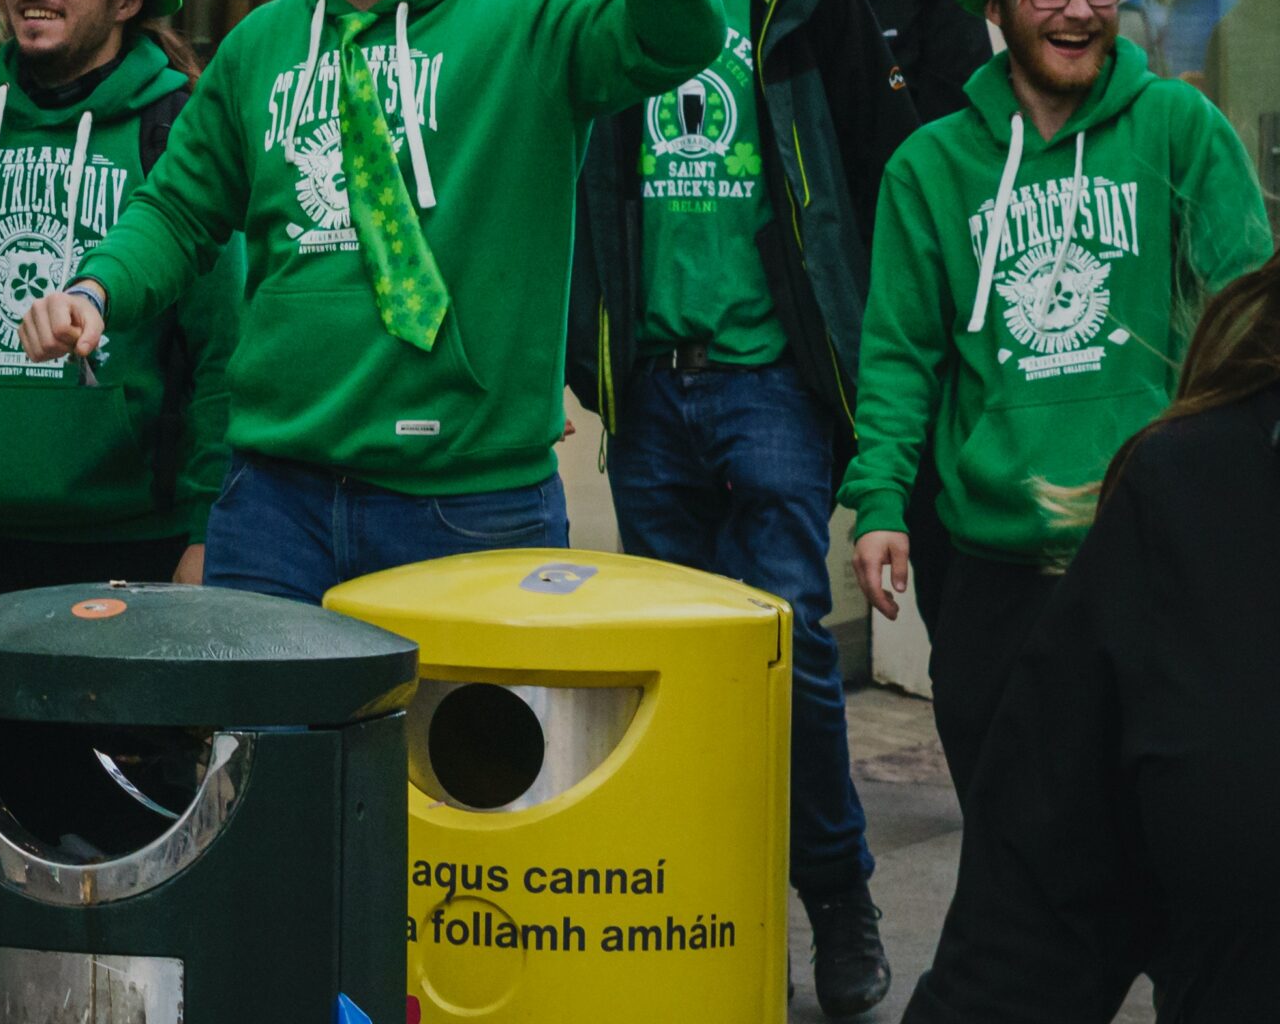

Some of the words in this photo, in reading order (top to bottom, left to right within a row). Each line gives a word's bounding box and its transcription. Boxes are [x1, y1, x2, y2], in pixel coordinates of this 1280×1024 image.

[643, 179, 716, 198] ATRICK'S
[718, 179, 755, 198] DAY
[668, 160, 717, 178] SAINT
[1009, 175, 1090, 206] RELAND
[80, 165, 128, 238] DAY
[1094, 181, 1140, 257] DAY
[412, 859, 510, 904] agus
[523, 858, 667, 895] cannaí
[431, 909, 586, 953] follamh
[600, 913, 736, 953] amháin
